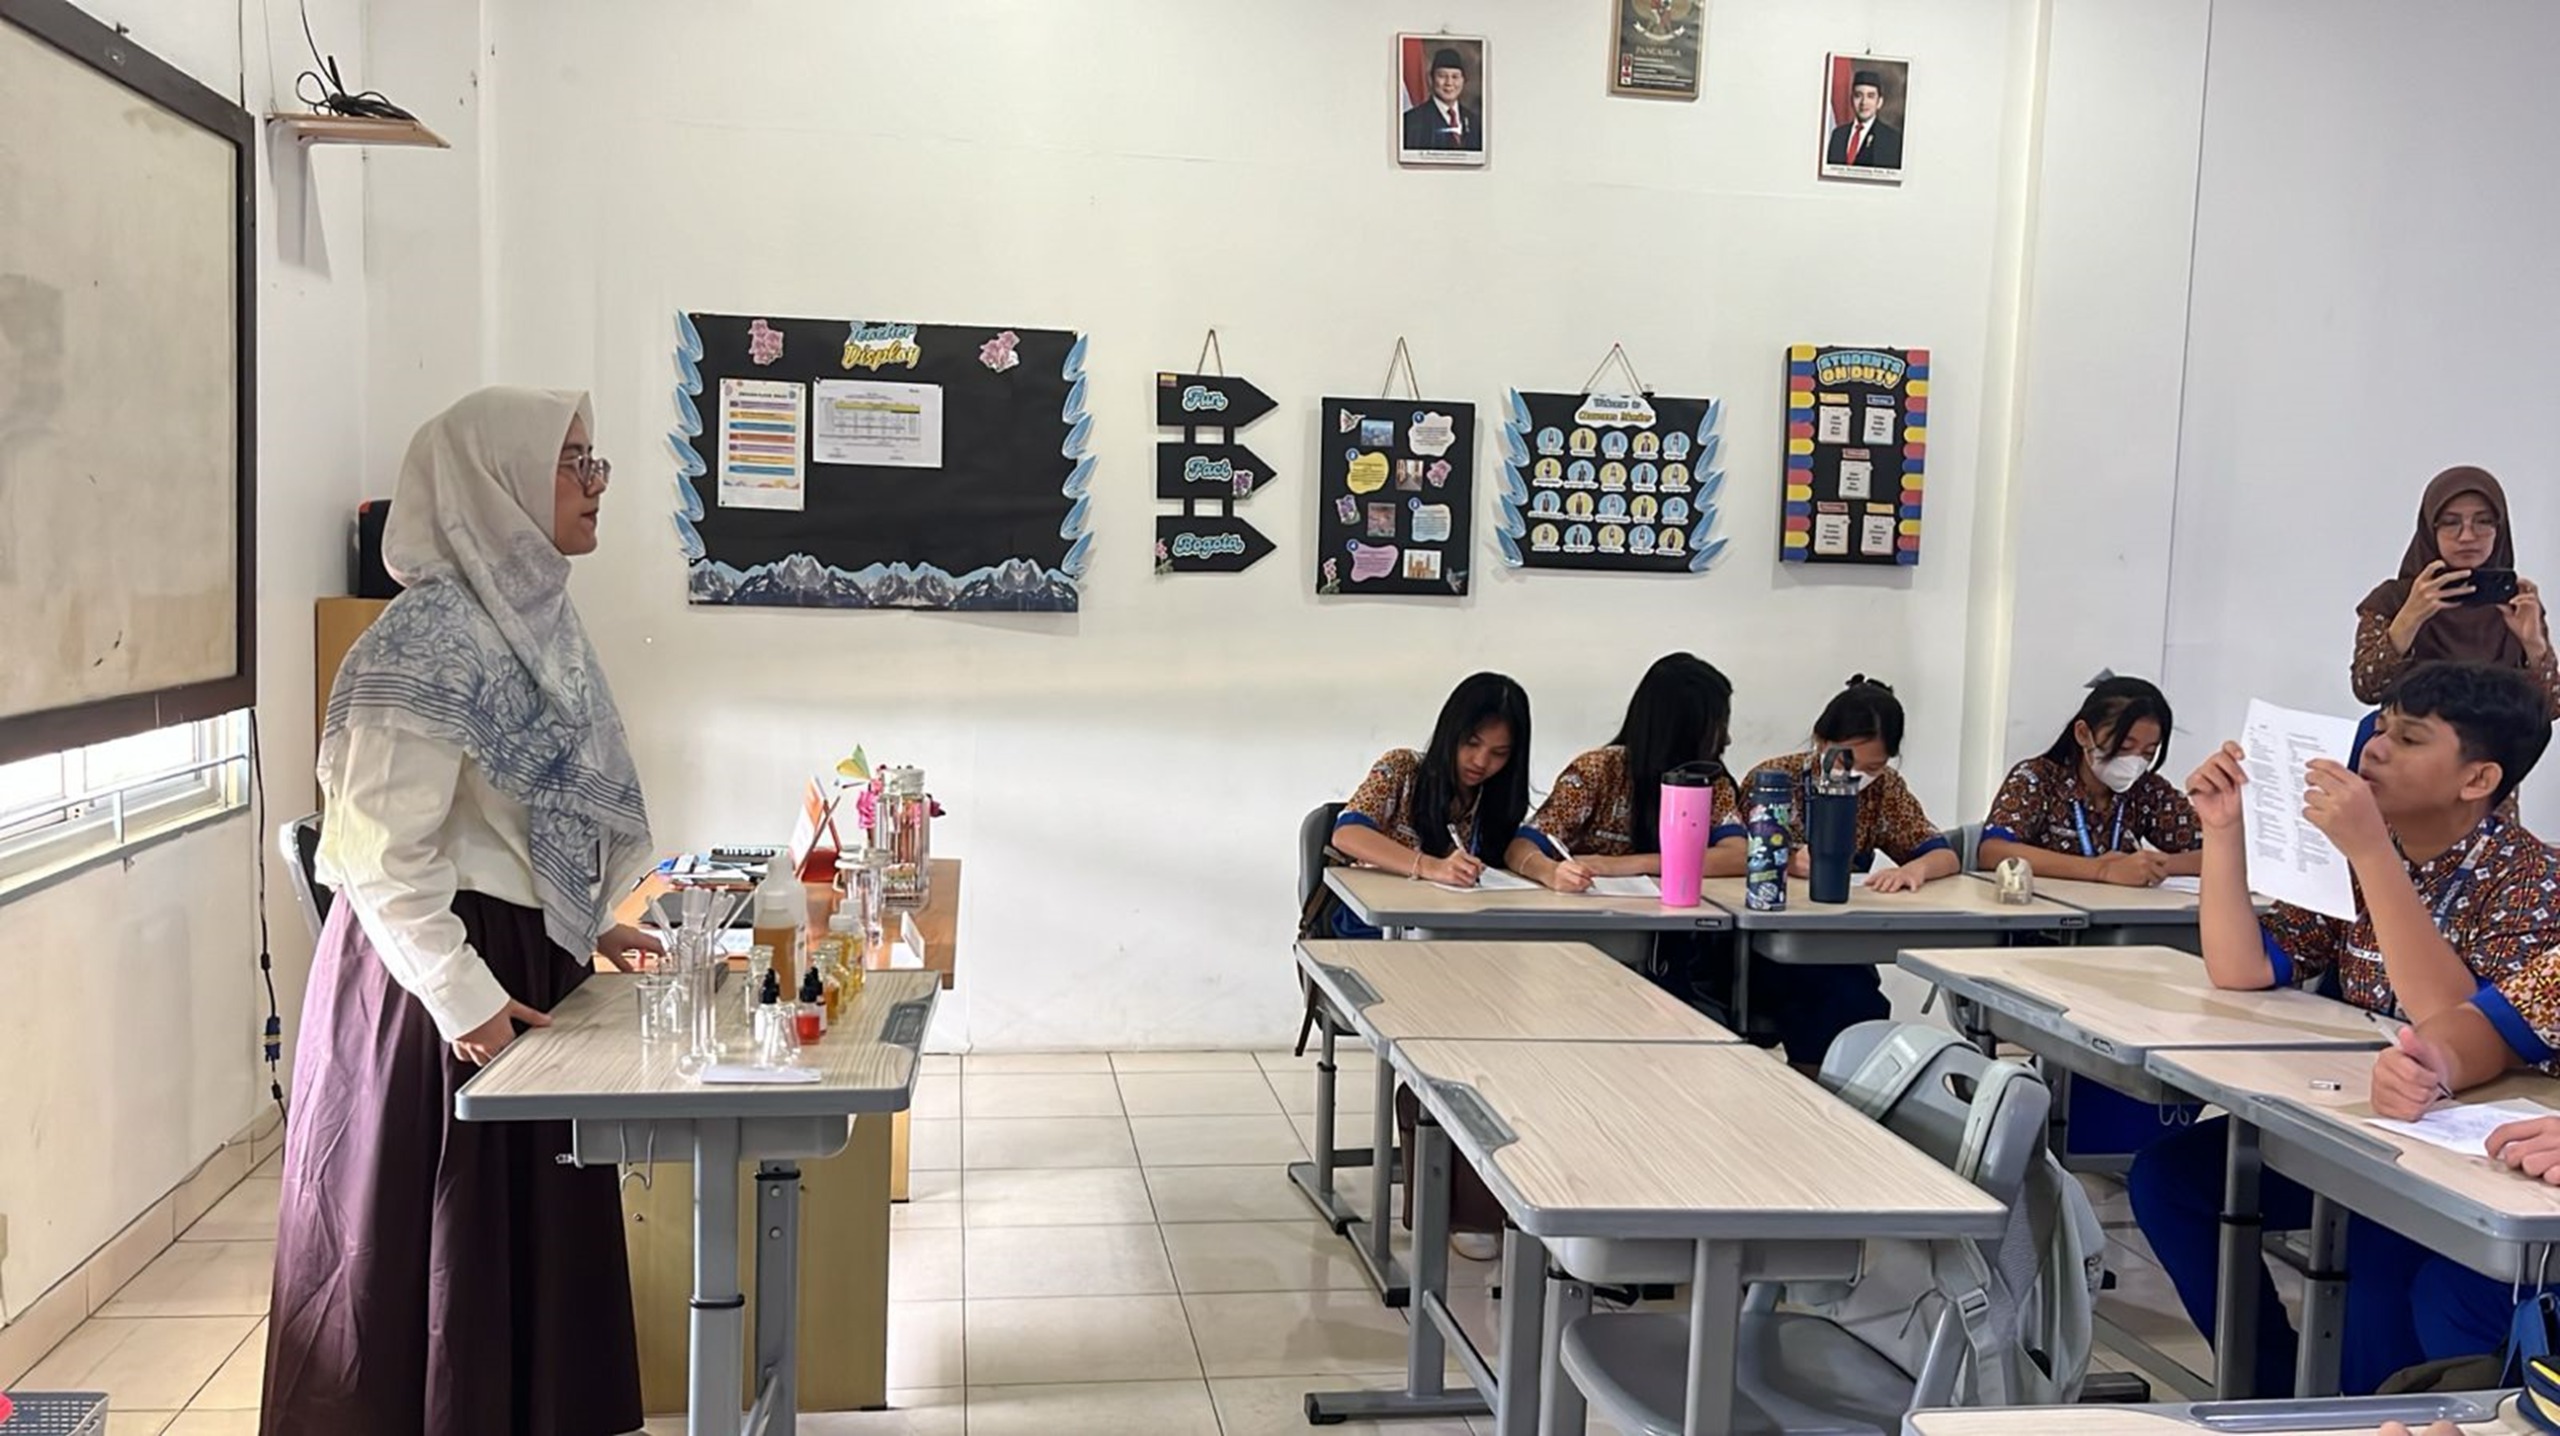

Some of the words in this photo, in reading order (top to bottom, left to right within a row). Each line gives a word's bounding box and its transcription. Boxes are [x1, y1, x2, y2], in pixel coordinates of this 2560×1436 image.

[842, 341, 921, 371] Display
[1820, 353, 1902, 374] STUDENTS
[1822, 366, 1847, 382] ON
[1851, 365, 1898, 386] DUTY
[1184, 387, 1227, 410] Fun
[1186, 458, 1231, 480] Fact
[1174, 535, 1243, 557] Bogota
[2435, 879, 2463, 915] SCHOOL
